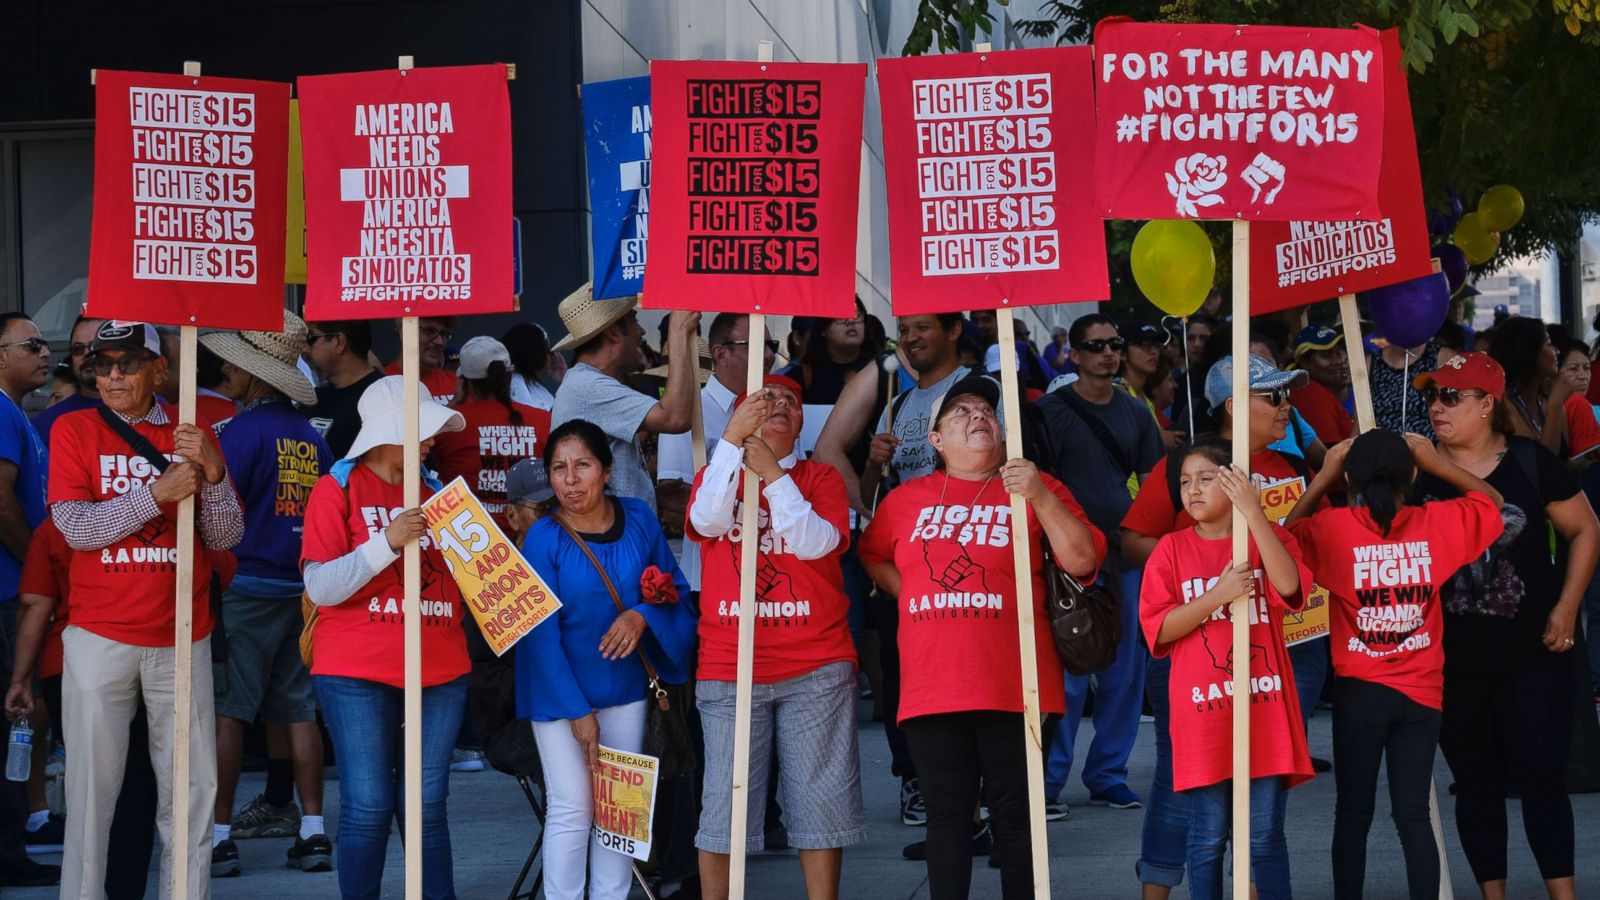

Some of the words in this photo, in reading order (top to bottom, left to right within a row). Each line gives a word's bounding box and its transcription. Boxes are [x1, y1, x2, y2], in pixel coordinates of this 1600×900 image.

[1103, 52, 1168, 82] FOR
[1180, 49, 1247, 77] THE
[1260, 49, 1373, 82] MANY
[132, 92, 202, 124] FIGHT
[193, 101, 201, 124] FOR
[204, 95, 252, 127] $15
[688, 83, 764, 115] FIGHT
[754, 90, 763, 114] FOR
[765, 82, 819, 117] $15
[916, 81, 993, 114] FIGHT
[983, 87, 991, 111] FOR
[995, 78, 1049, 112] $15
[1144, 85, 1204, 112] NOT
[1209, 84, 1264, 109] THE
[1268, 84, 1335, 110] FEW
[355, 102, 453, 135] AMERICA
[1117, 111, 1358, 146] #FIGHTFOR15
[133, 129, 204, 163] FIGHT
[193, 139, 201, 163] FOR
[203, 132, 253, 166] $15
[370, 135, 440, 167] NEEDS
[689, 122, 764, 153] FIGHT
[754, 129, 762, 152] FOR
[766, 122, 818, 155] $15
[917, 120, 995, 154] FIGHT
[984, 126, 993, 151] FOR
[996, 117, 1052, 152] $15
[135, 168, 203, 199] FIGHT
[205, 171, 252, 203] $15
[365, 167, 446, 199] UNIONS
[689, 161, 764, 193] FIGHT
[754, 168, 762, 193] FOR
[765, 160, 817, 194] $15
[920, 160, 996, 192] FIGHT
[999, 157, 1052, 191] $15
[135, 205, 205, 239] FIGHT
[195, 215, 203, 239] FOR
[206, 208, 254, 242] $15
[363, 199, 450, 228] AMERICA
[689, 200, 764, 231] FIGHT
[754, 207, 762, 231] FOR
[765, 199, 817, 233] $15
[922, 198, 999, 232] FIGHT
[988, 204, 997, 229] FOR
[1000, 195, 1055, 230] $15
[360, 228, 454, 256] NECESITA
[689, 240, 764, 270] FIGHT
[765, 239, 817, 272] $15
[924, 237, 1000, 270] FIGHT
[1002, 235, 1056, 269] $15
[1283, 222, 1388, 270] SINDICATOS
[136, 245, 204, 276] FIGHT
[207, 246, 254, 279] $15
[349, 257, 465, 285] SINDICATOS
[1279, 249, 1396, 287] #FIGHTFOR15
[341, 286, 471, 301] #FIGHTFOR15
[478, 426, 515, 437] WHEN
[516, 427, 535, 437] WE
[480, 437, 536, 455] FIGHT
[276, 438, 318, 460] UNON
[901, 444, 925, 456] SAVE
[478, 482, 507, 492] LUCH
[479, 470, 509, 482] CUA
[916, 505, 1012, 527] FIGHT
[438, 508, 490, 571] 15
[910, 525, 953, 542] FOR
[958, 524, 1010, 547] $15
[1353, 543, 1404, 562] WHEN
[1405, 541, 1429, 557] WE
[101, 549, 113, 563] &
[116, 548, 130, 563] A
[133, 548, 177, 563] UNIO
[104, 565, 175, 573] CALIFORN
[476, 543, 510, 580] AND
[472, 563, 530, 612] UNION
[1354, 557, 1432, 589] FIGHT
[368, 597, 380, 612] &
[384, 598, 398, 613] A
[402, 599, 452, 617] NION
[719, 600, 727, 616] &
[729, 601, 740, 616] A
[909, 598, 917, 613] &
[920, 595, 930, 610] A
[934, 592, 1002, 609] UNION
[1356, 588, 1391, 606] WE
[1394, 585, 1433, 603] WIN
[484, 585, 545, 640] RIGHTS
[497, 607, 548, 649] #FIGHTFOR15
[913, 610, 1000, 622] CALIFORNIA
[1192, 687, 1206, 703] &
[1208, 683, 1223, 700] A
[611, 767, 644, 786] END
[617, 755, 653, 769] BECAUSE
